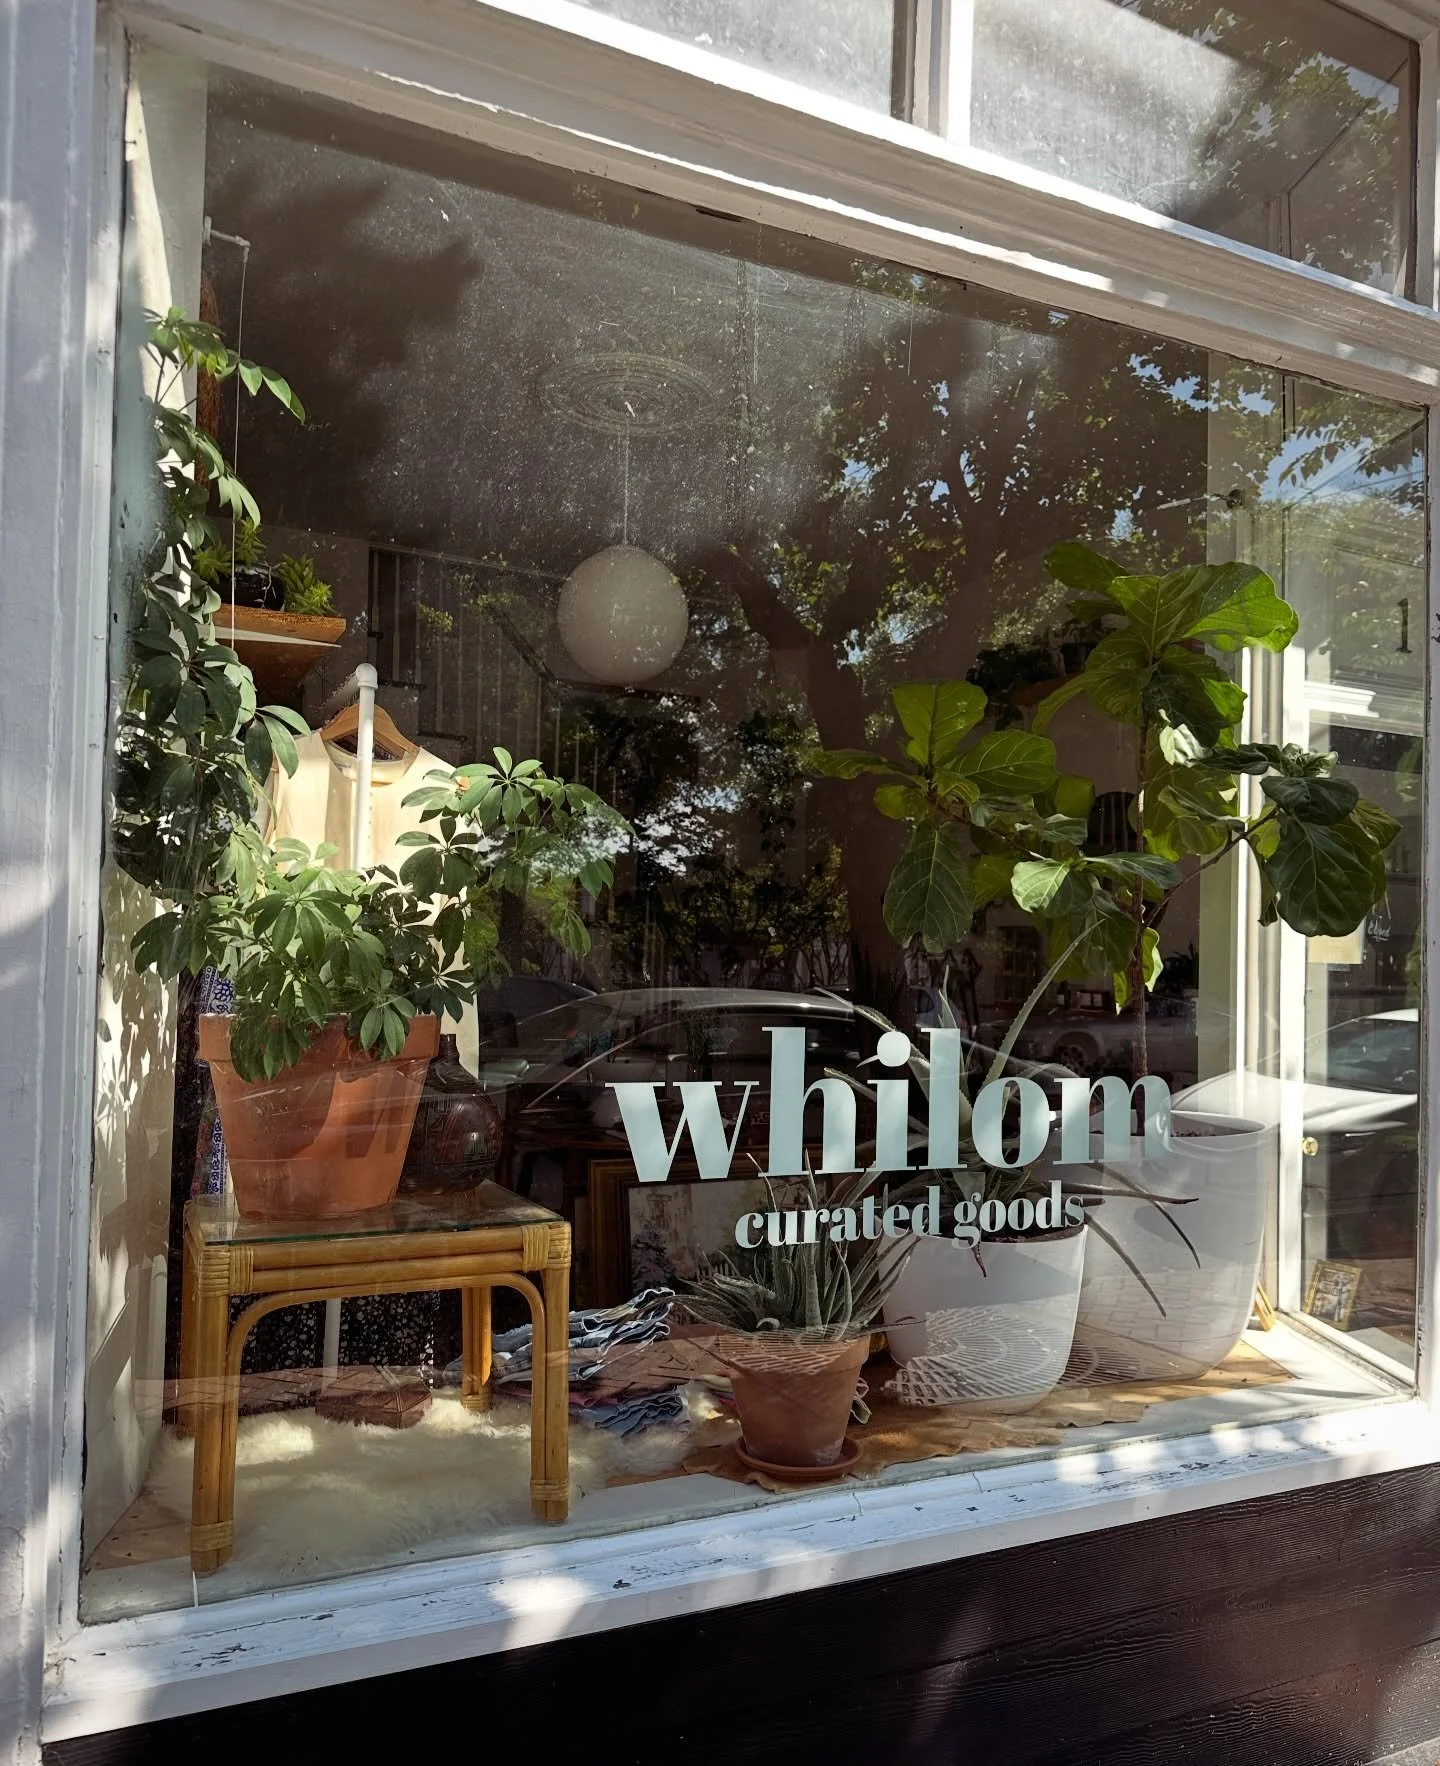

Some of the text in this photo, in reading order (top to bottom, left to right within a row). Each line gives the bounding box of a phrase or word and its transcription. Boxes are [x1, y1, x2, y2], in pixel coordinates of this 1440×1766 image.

[605, 1026, 1176, 1182] whilom
[735, 1180, 1085, 1250] curated goods
